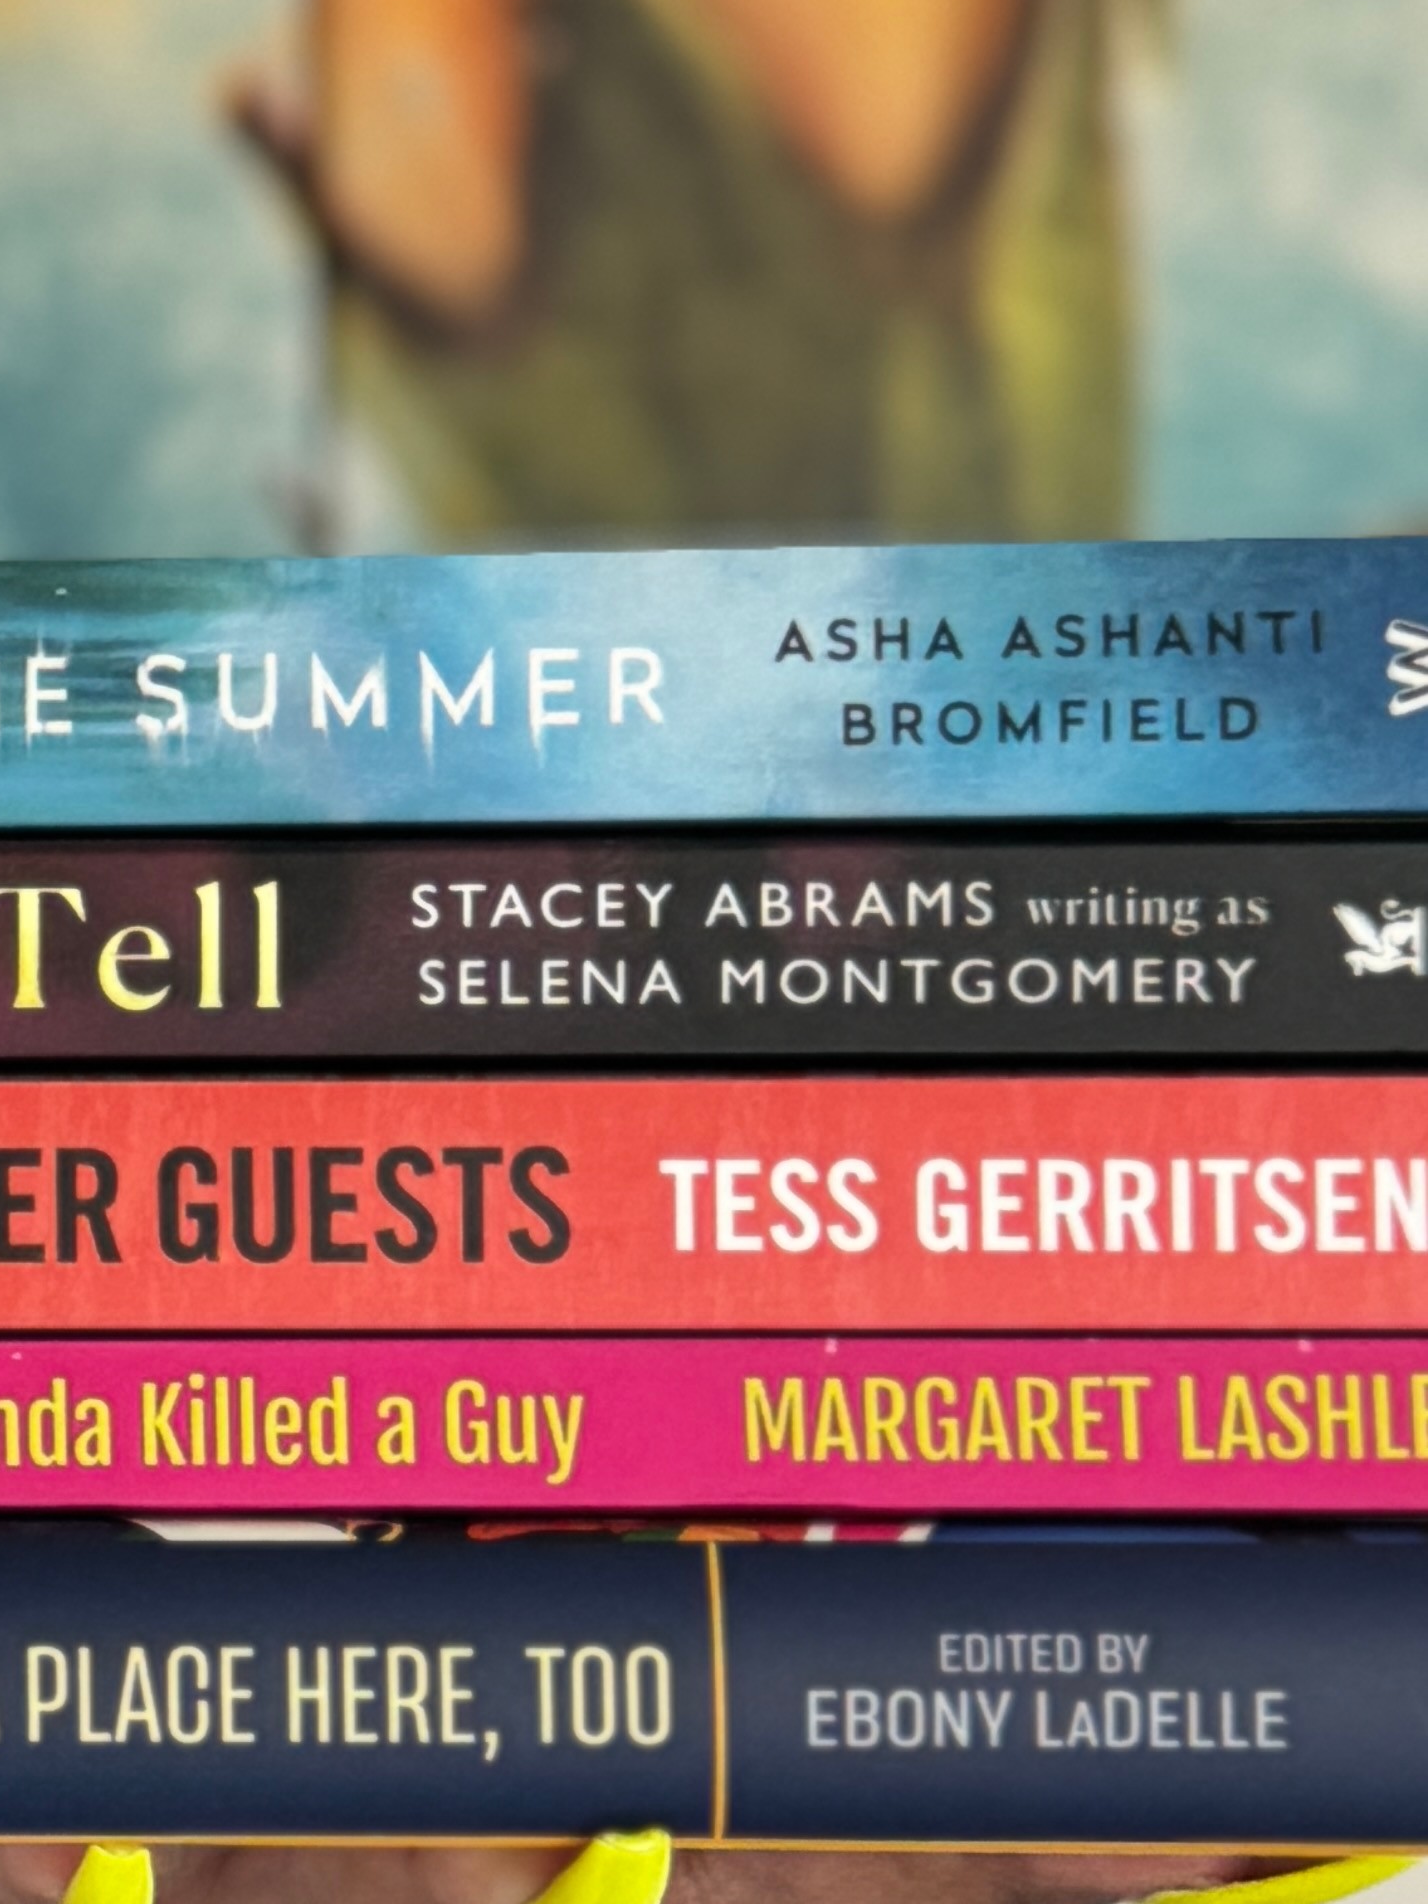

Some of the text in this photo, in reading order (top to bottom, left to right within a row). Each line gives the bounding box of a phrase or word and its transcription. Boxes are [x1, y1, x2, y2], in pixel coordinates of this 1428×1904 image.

[775, 609, 1324, 662] ASHA ASHANTI
[136, 646, 664, 756] SUMMER
[842, 696, 1259, 746] BROMFIELD
[411, 882, 1270, 936] STACEY ABRAMS writing as
[418, 955, 1256, 1005] SELENA MONTGOMERY
[157, 1144, 572, 1264] GUESTS
[660, 1158, 1428, 1254] TESS GERRITSEN
[142, 1373, 349, 1466] Killed
[376, 1394, 415, 1466] a
[445, 1379, 584, 1484] Guy
[745, 1376, 1151, 1461] MARGARET
[938, 1634, 1148, 1674] EDITED BY
[27, 1647, 254, 1744] PLACE
[288, 1647, 501, 1763] HERE,
[525, 1647, 672, 1744] TOO
[806, 1693, 1011, 1748] EBONY
